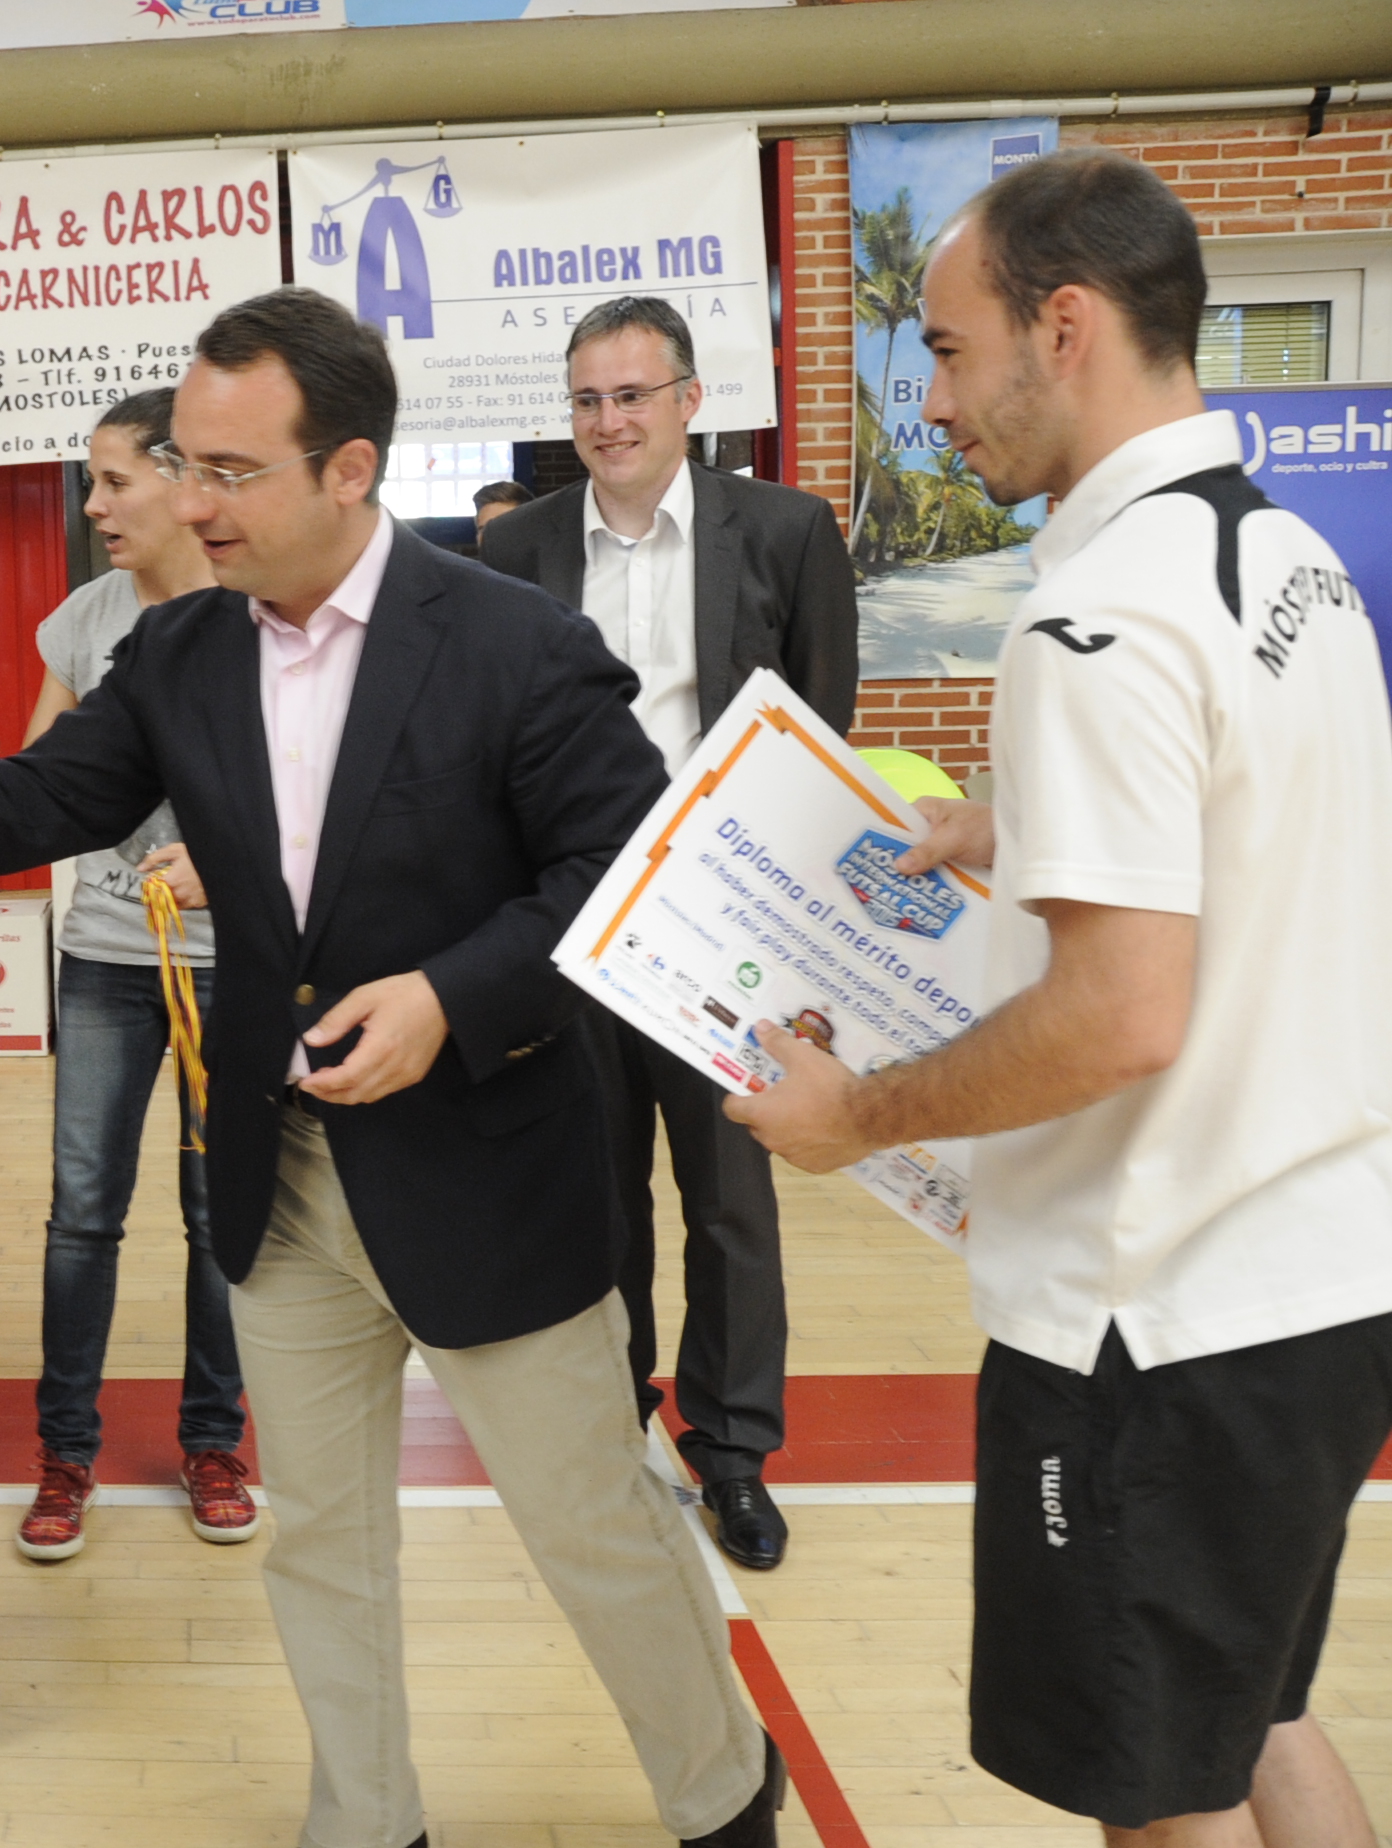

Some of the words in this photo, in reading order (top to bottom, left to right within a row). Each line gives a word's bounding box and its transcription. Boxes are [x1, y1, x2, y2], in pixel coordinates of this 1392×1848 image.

[210, 0, 320, 18] CLUB
[433, 174, 453, 209] G
[57, 210, 87, 247] &
[104, 180, 271, 246] CARLOS
[311, 222, 343, 256] M
[494, 244, 643, 288] Albalex
[656, 235, 723, 278] MG
[501, 297, 727, 328] ASEÍA
[17, 345, 111, 365] LOMAS
[423, 355, 471, 369] Ciudad
[475, 352, 528, 367] Dolores
[40, 367, 83, 386] Tlf.
[94, 362, 192, 382] 91646
[448, 374, 490, 388] 28931
[495, 371, 558, 387] Móstoles
[425, 397, 442, 410] 07
[446, 395, 463, 409] 55
[476, 395, 503, 407] Fax:
[508, 393, 524, 406] 91
[528, 392, 554, 405] 614
[716, 383, 743, 396] 499
[893, 377, 931, 404] Bi
[44, 437, 57, 449] a
[1319, 461, 1345, 472] ocio
[1345, 462, 1354, 473] y
[859, 838, 966, 910] MÓOLES
[716, 817, 806, 901] Diploma
[806, 899, 835, 920] al
[831, 920, 911, 979] mérito
[835, 861, 902, 908] FUTSAL
[901, 902, 945, 932] CUP
[754, 901, 839, 968] demostrado
[757, 933, 794, 960] play
